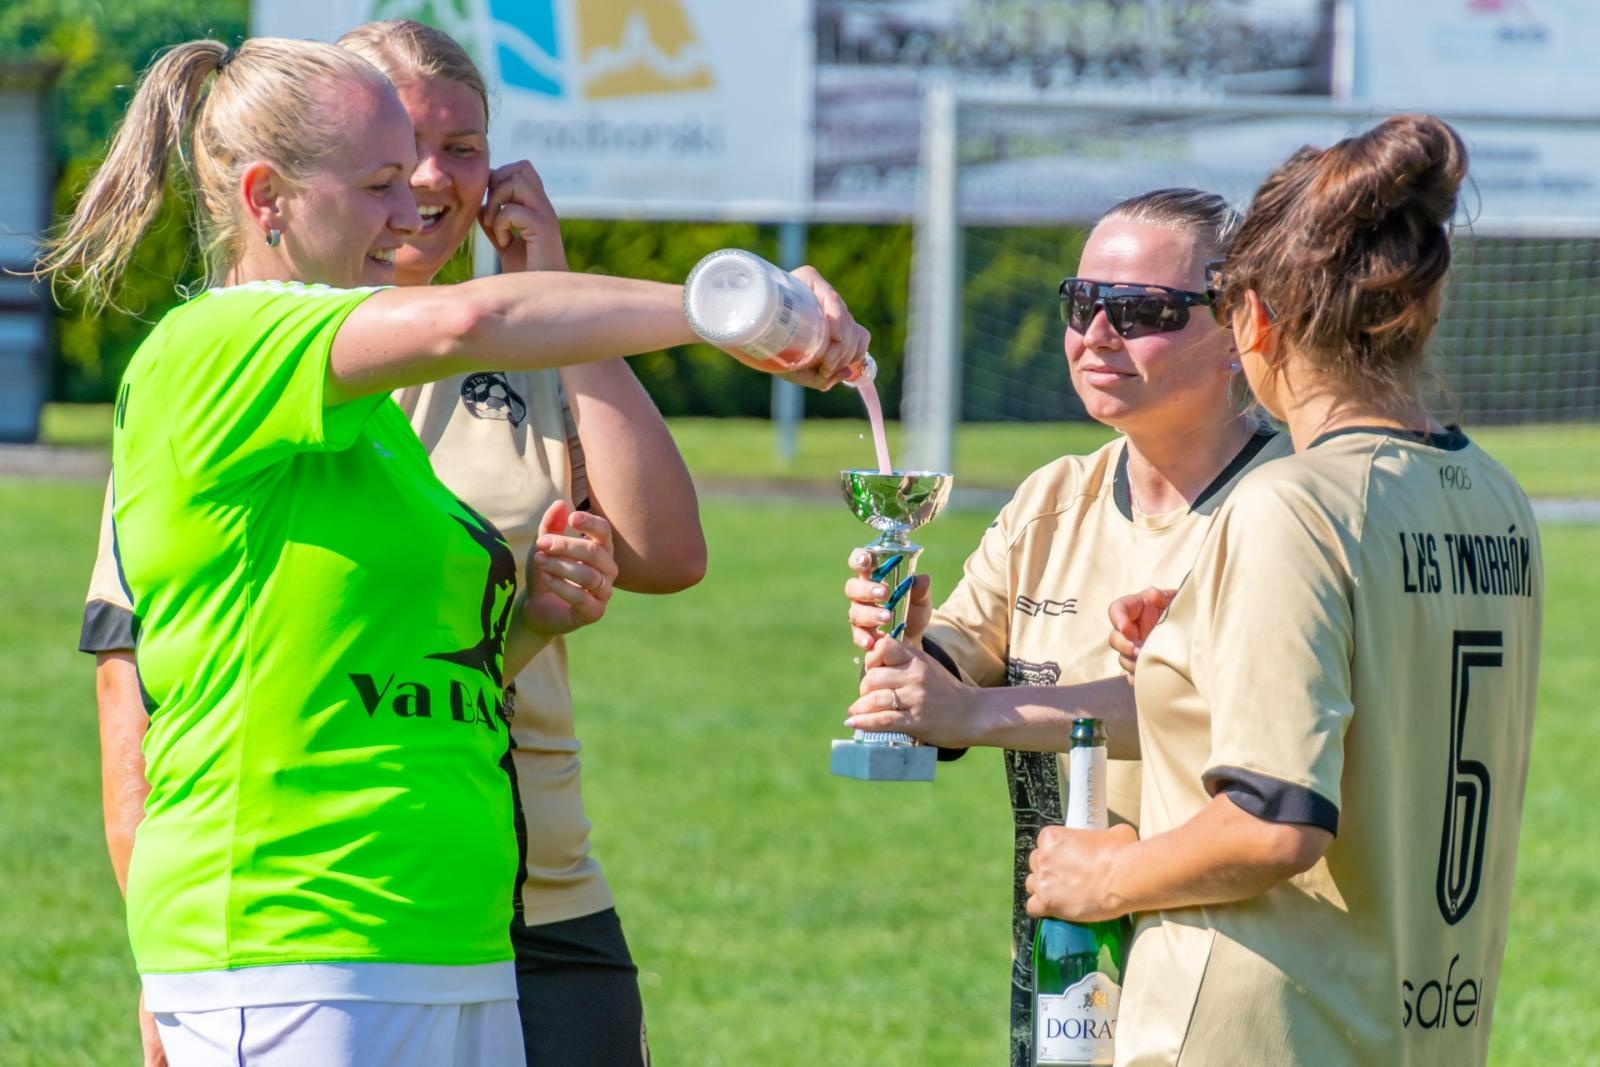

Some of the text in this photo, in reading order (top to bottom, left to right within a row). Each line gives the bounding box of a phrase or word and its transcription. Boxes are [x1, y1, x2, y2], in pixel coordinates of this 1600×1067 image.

[1439, 465, 1472, 490] 1905
[348, 672, 432, 719] Va
[1437, 630, 1503, 926] 6
